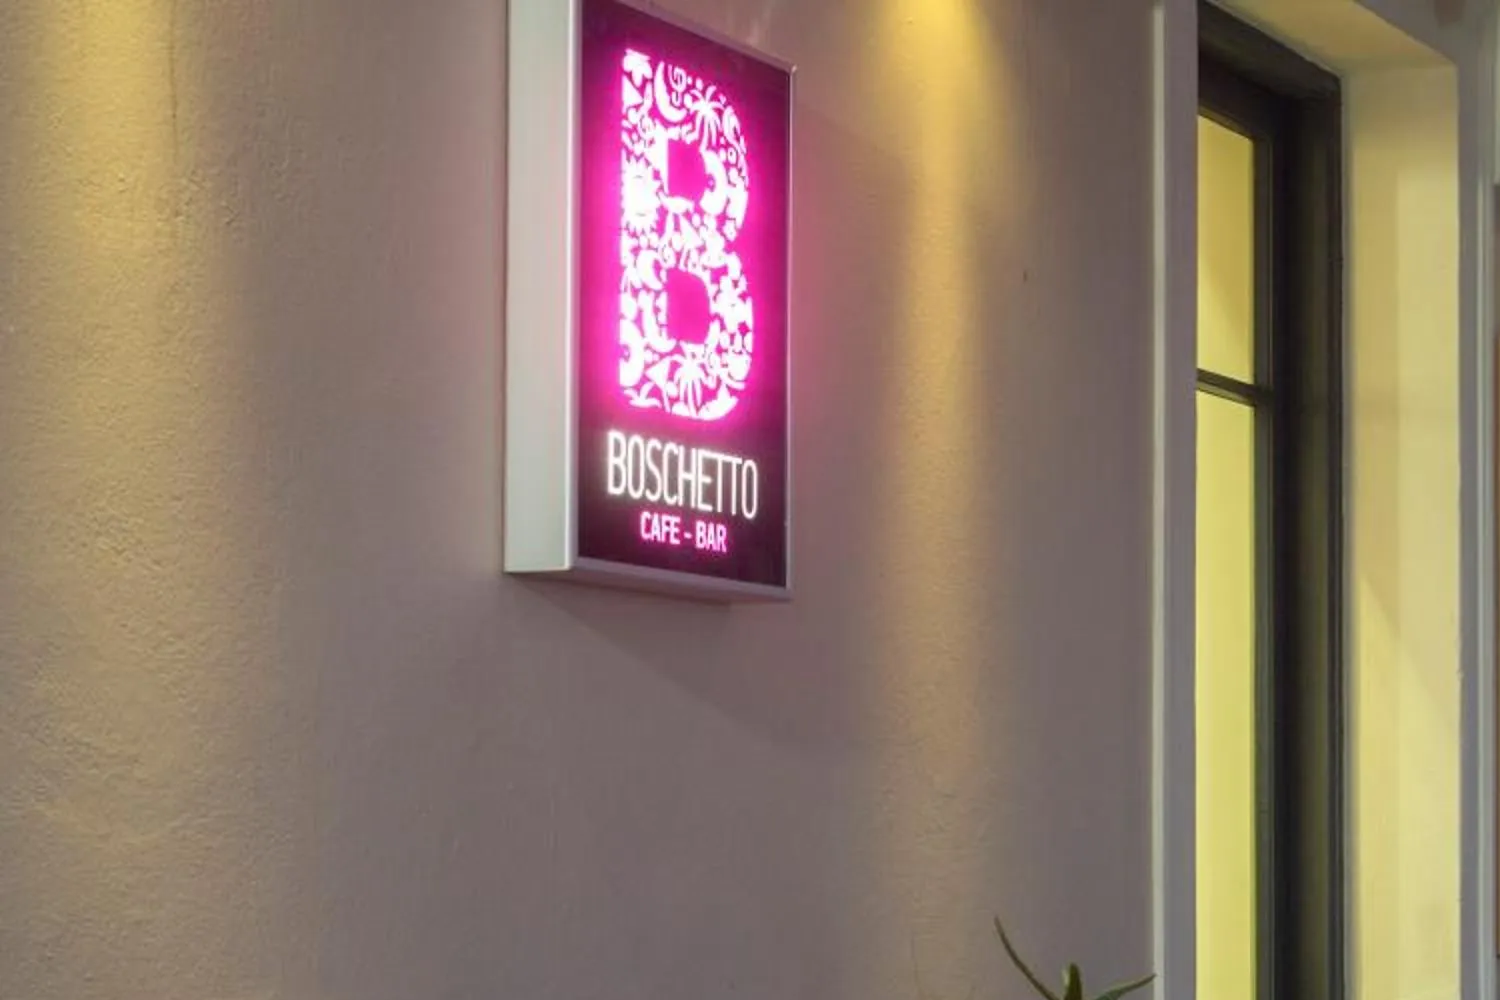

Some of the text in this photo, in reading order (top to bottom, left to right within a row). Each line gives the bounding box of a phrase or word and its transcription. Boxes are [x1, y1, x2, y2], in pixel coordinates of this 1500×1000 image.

[620, 48, 754, 420] B
[608, 429, 758, 520] BOSCHETTO
[640, 511, 681, 545] CAFE
[695, 519, 728, 553] BAR
